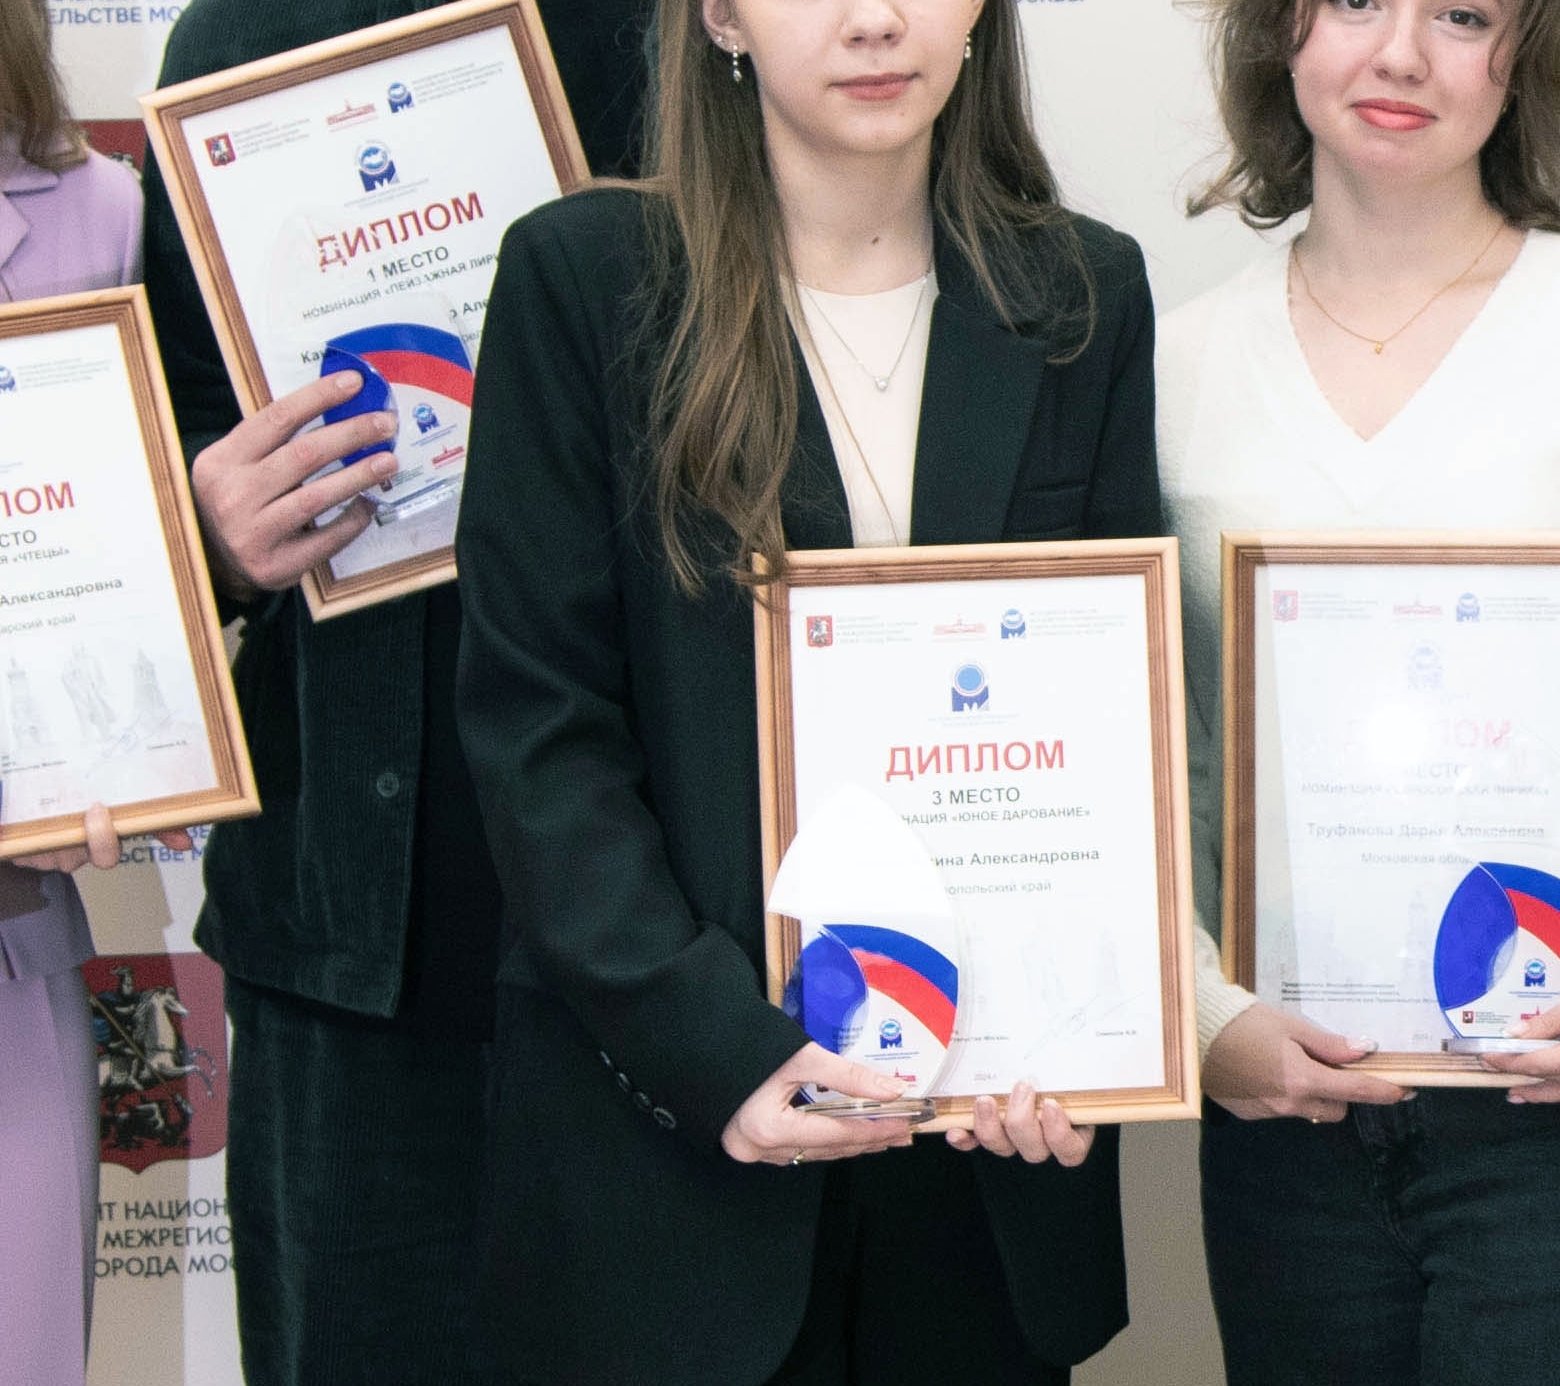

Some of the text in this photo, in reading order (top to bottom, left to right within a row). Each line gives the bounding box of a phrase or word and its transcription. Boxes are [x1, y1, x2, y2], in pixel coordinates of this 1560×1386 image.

[316, 191, 484, 273] ДИПЛОМ
[366, 246, 450, 283] 1 МЕСТО
[302, 288, 382, 320] НОМИНАЦИЯ
[12, 546, 71, 563] «ЧТЕЦЫ»
[46, 612, 77, 628] край
[885, 739, 1065, 783] ДИПЛОМ
[932, 786, 1021, 806] 3 МЕСТО
[951, 807, 1091, 822] «ЮНОЕ ДАРОВАНИЕ»
[969, 850, 1100, 866] Александровна
